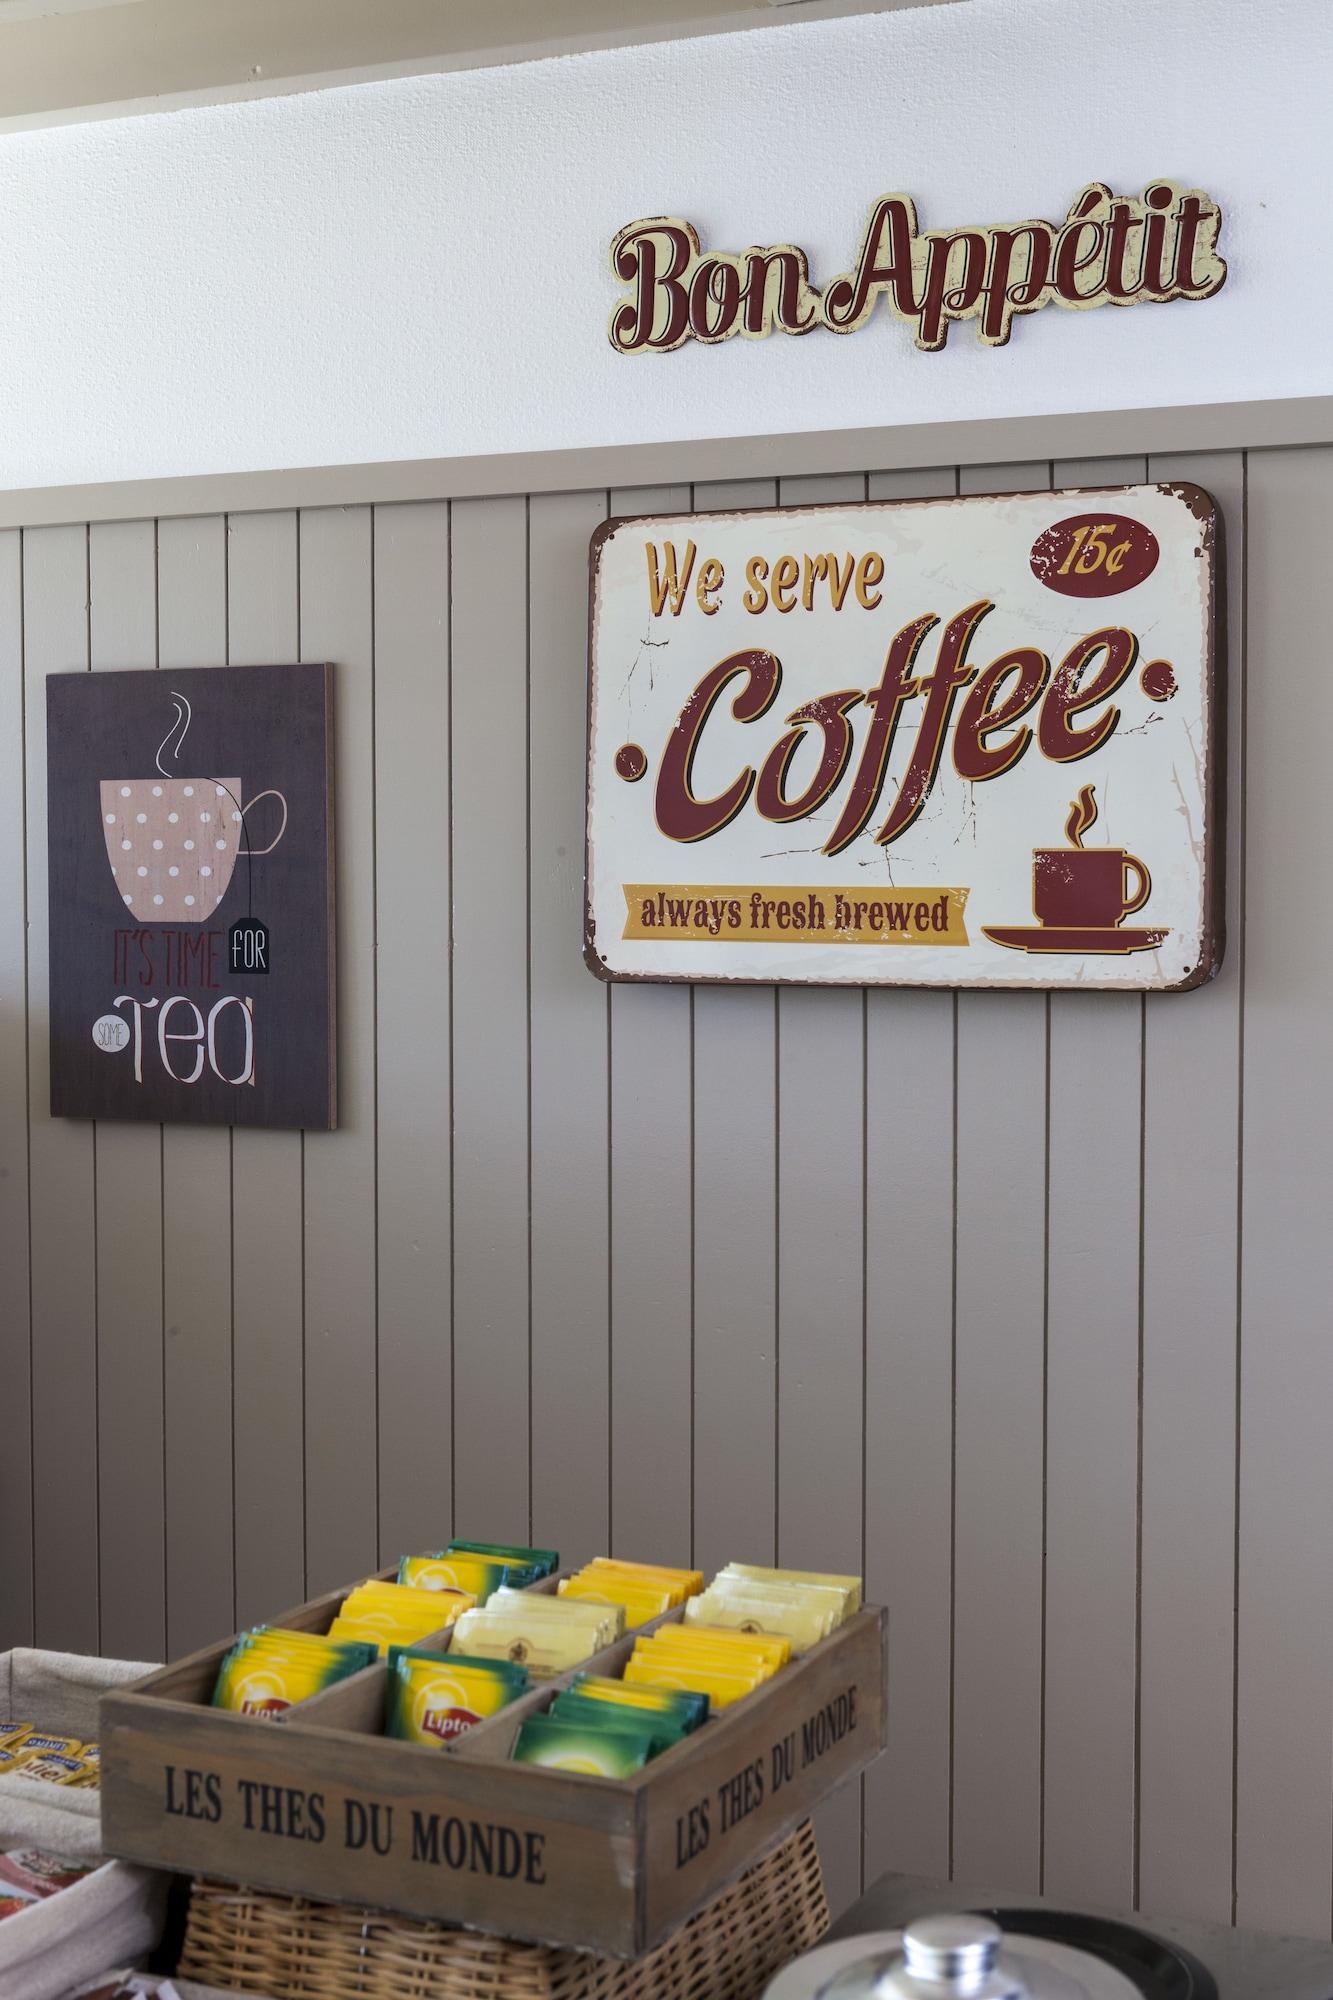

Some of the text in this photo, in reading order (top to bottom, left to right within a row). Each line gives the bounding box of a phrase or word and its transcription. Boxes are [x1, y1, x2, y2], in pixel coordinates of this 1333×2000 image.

[613, 185, 1217, 350] Bon Appétit
[645, 538, 885, 617] We serve
[1057, 523, 1132, 577] 15¢
[654, 599, 1140, 857] Coffee
[641, 892, 949, 936] always fresh brewed
[113, 928, 266, 989] IT'S TIME FOR
[98, 995, 256, 1087] SOME Tea
[426, 1711, 472, 1738] Lipto
[676, 1685, 857, 1870] LES THES DU MONDE
[165, 1766, 547, 1885] LES THES DU MONDE
